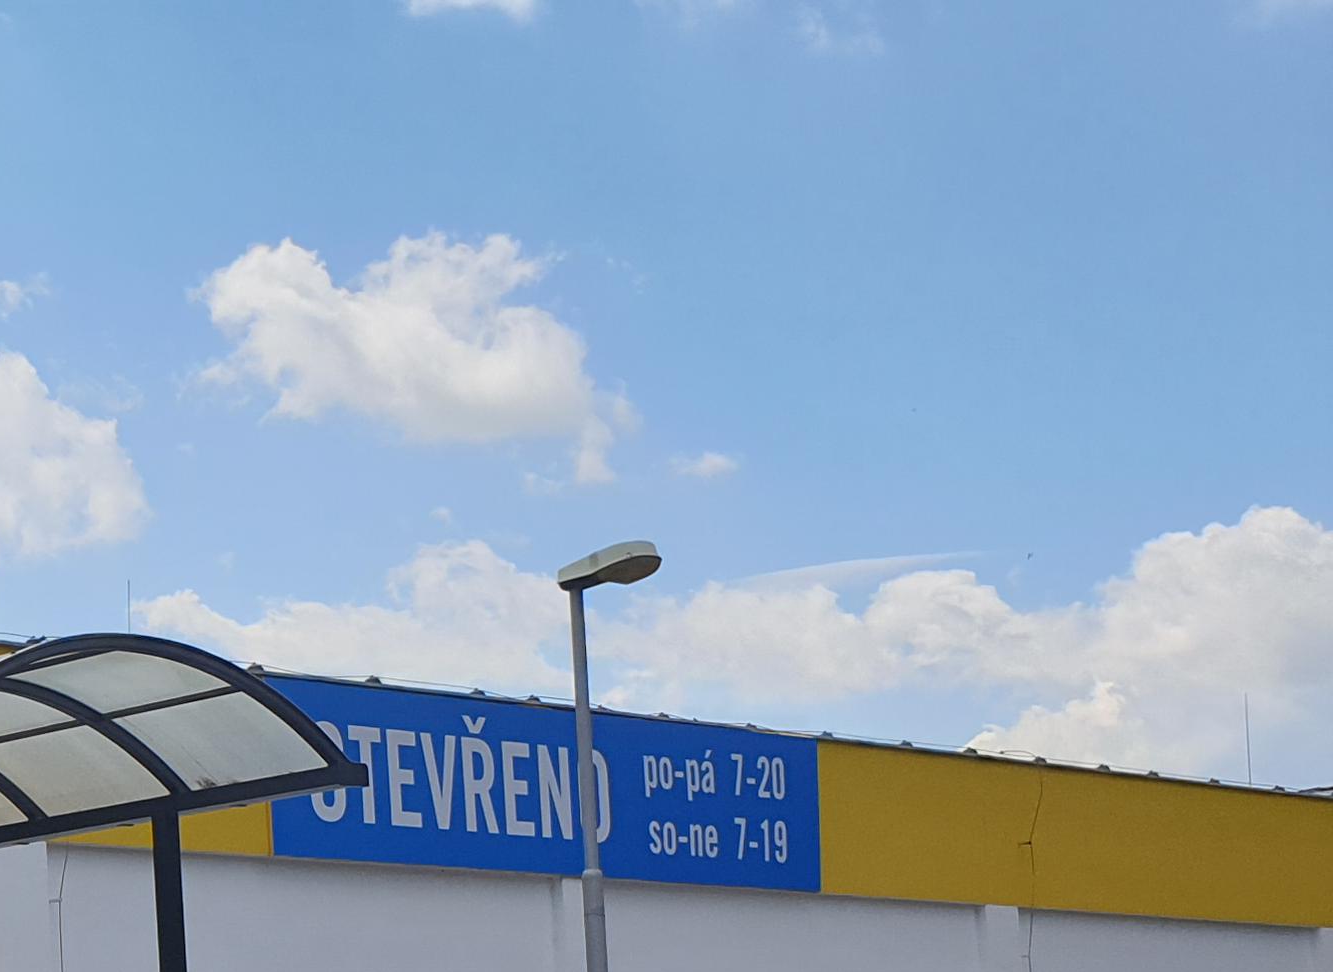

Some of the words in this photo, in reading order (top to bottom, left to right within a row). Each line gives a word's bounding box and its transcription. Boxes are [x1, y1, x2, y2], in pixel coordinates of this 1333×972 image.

[643, 749, 715, 801] po-pá
[731, 753, 785, 800] 7-20
[648, 820, 718, 858] so-ne
[733, 817, 788, 864] 7-19
